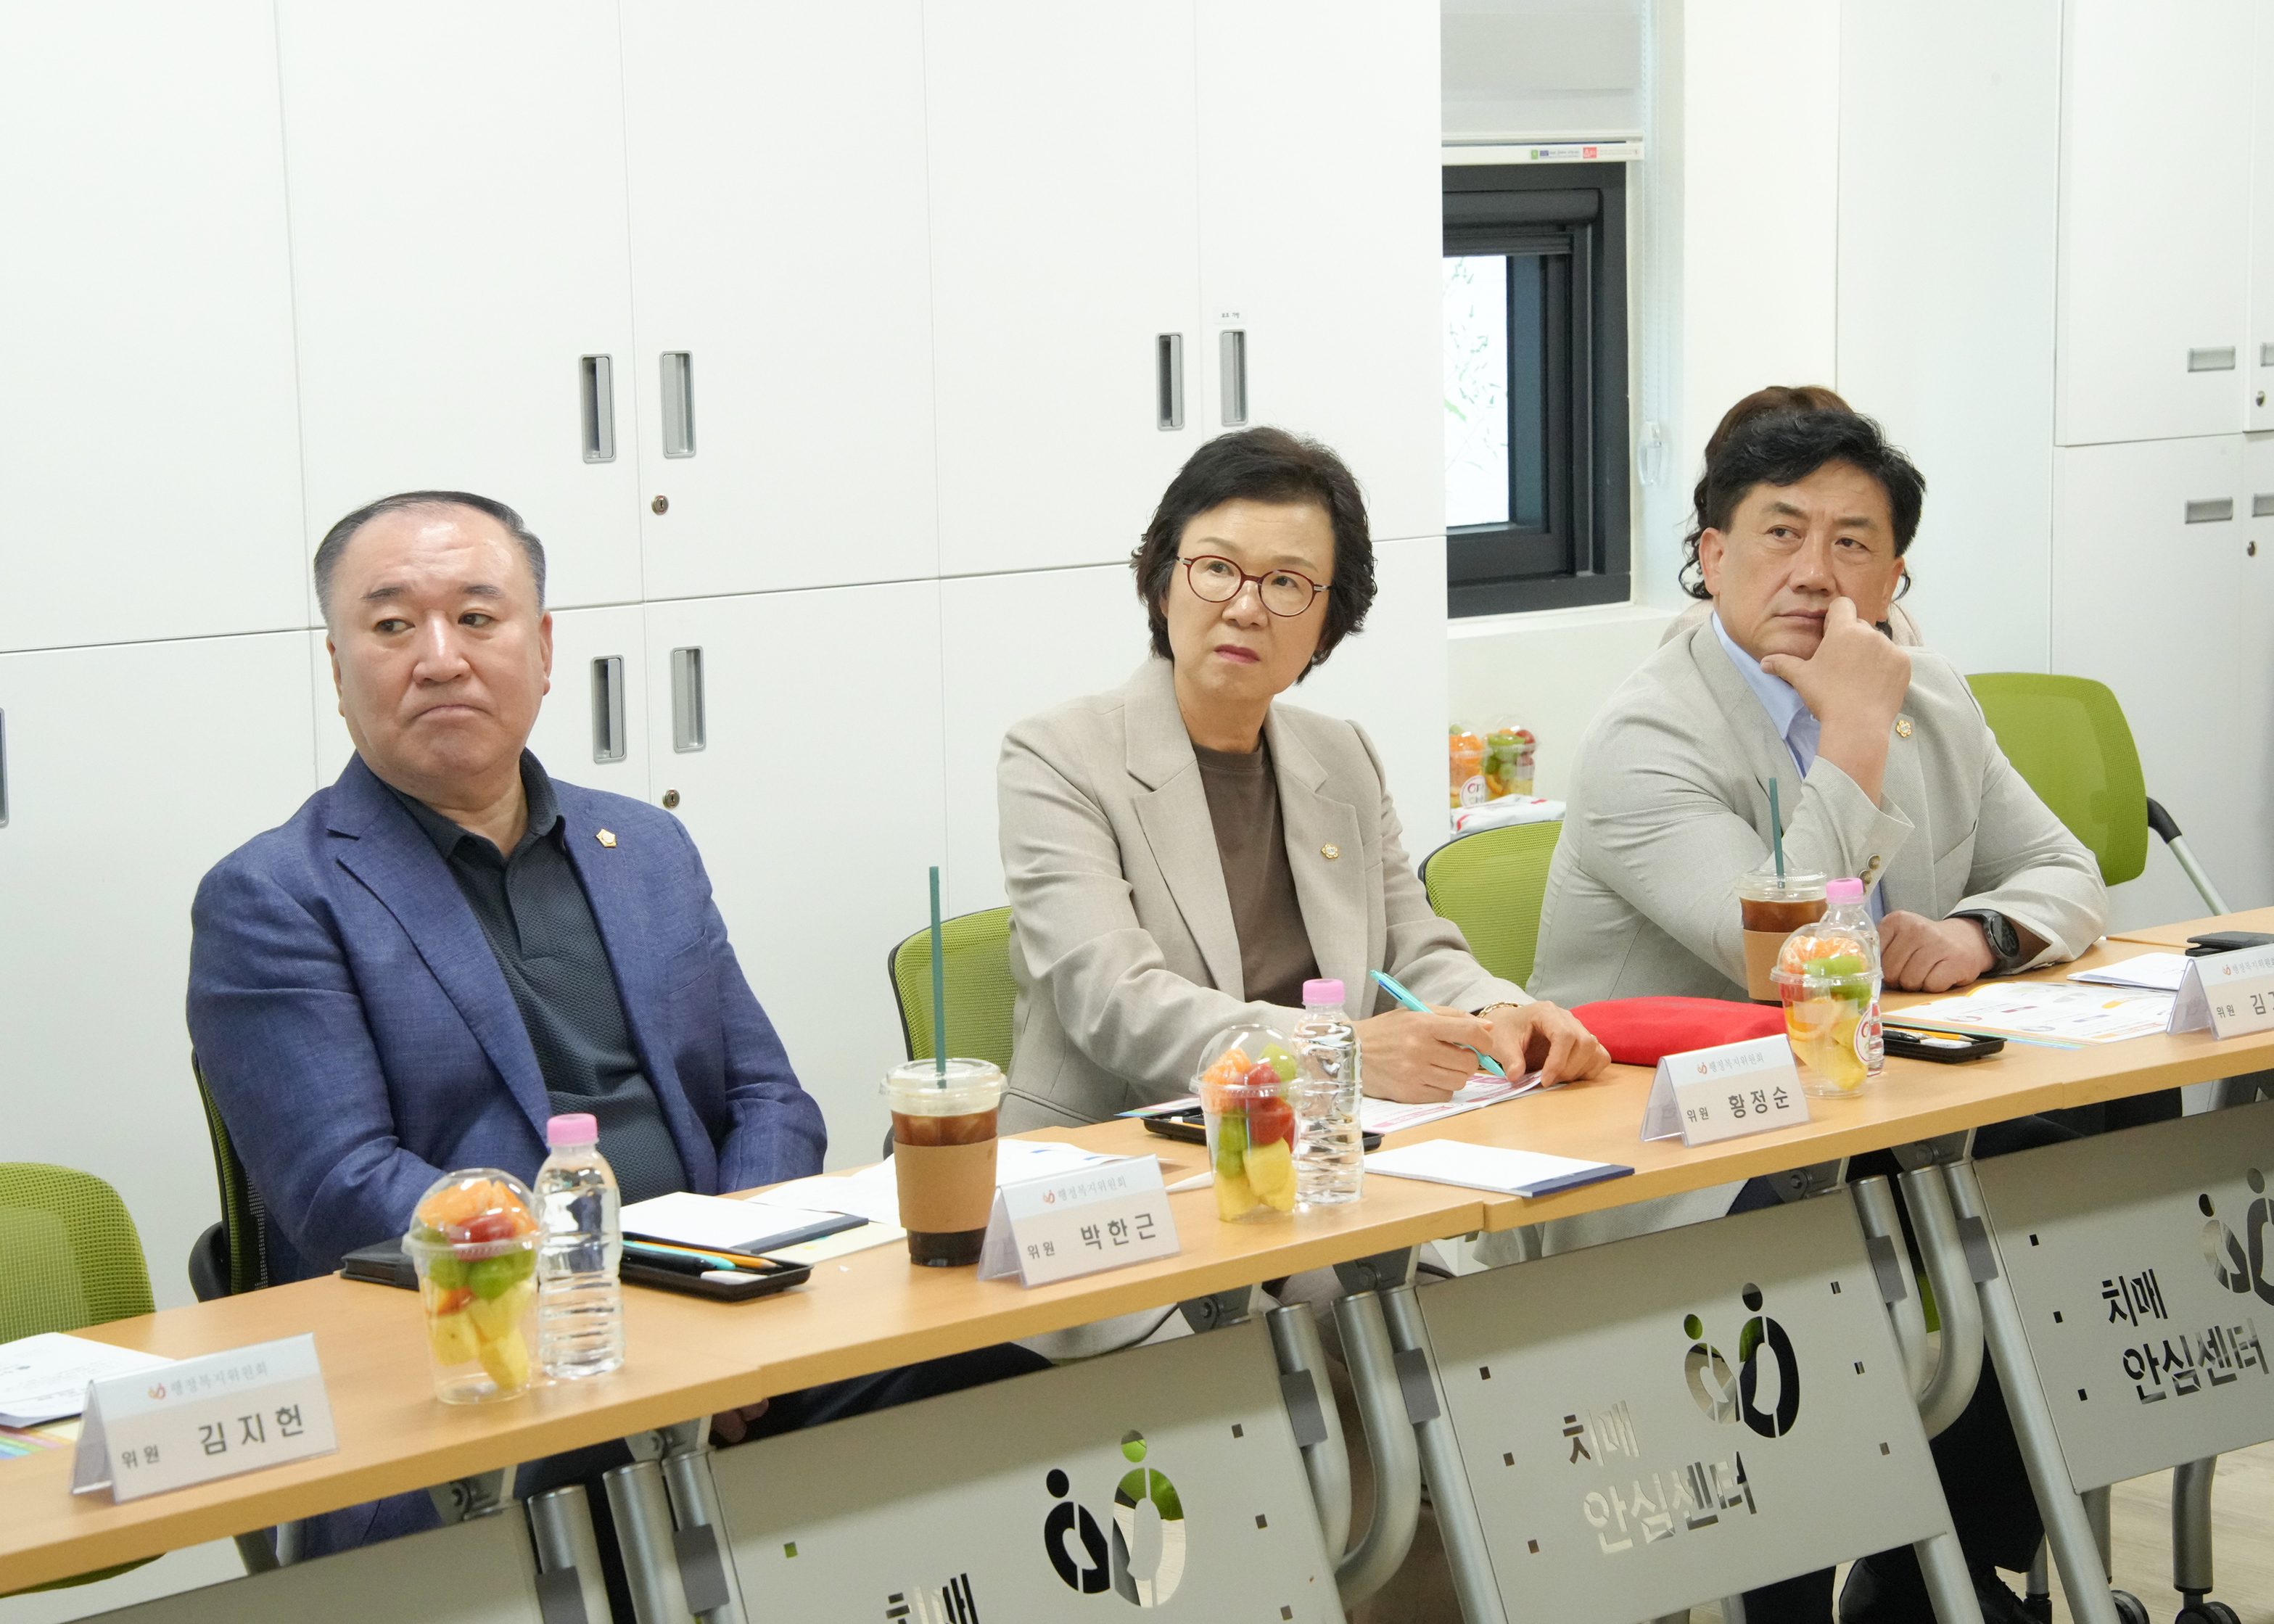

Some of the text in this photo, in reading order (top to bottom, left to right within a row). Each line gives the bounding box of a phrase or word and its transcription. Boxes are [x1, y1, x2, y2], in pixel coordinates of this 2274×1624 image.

[2216, 992, 2274, 1018] 위원 김
[1709, 1052, 1764, 1073] 행정복지위원회
[1686, 1087, 1789, 1123] 위원 황정순
[1058, 1175, 1126, 1202] 행정복지위원회
[1027, 1213, 1155, 1260] 위원 박한근
[2101, 1269, 2168, 1327] 치매
[171, 1361, 268, 1396] 행정복지위원회
[2123, 1317, 2270, 1405] 안심센터
[122, 1404, 304, 1470] 위원 김지헌
[1562, 1400, 1641, 1466] 치매
[1583, 1451, 1758, 1554] 안심센터
